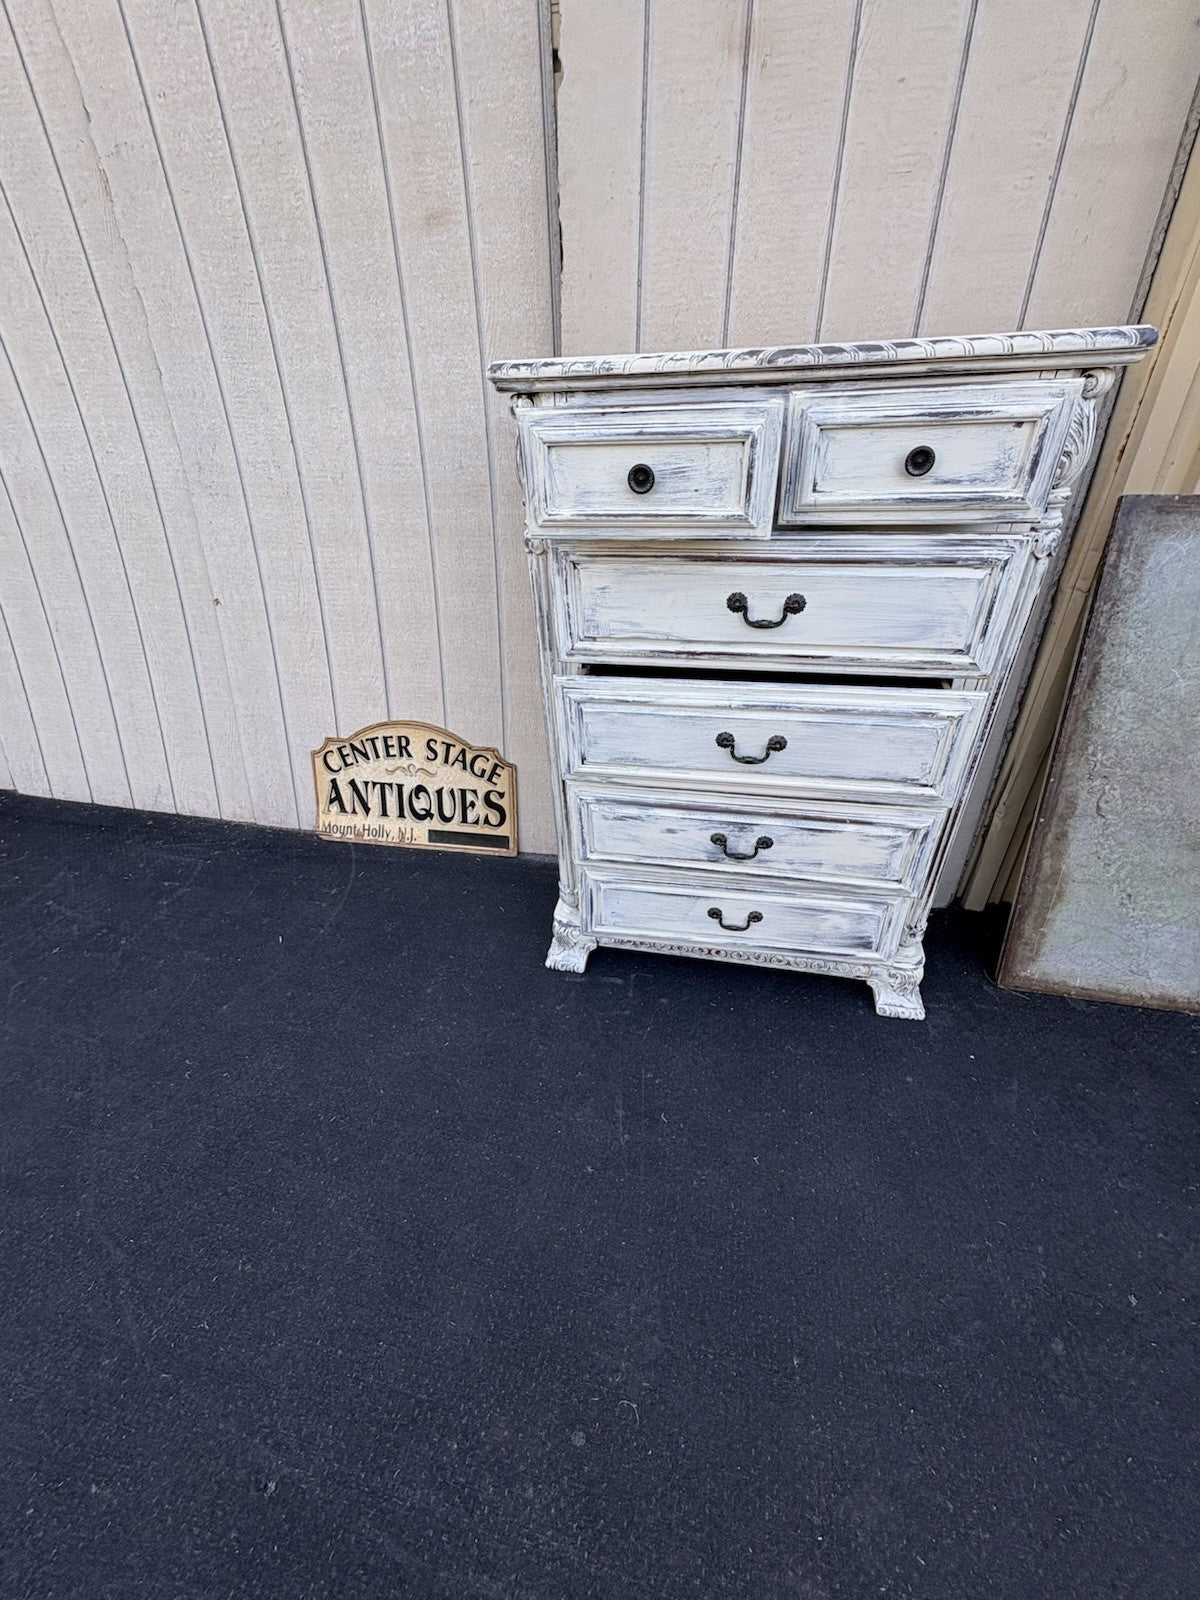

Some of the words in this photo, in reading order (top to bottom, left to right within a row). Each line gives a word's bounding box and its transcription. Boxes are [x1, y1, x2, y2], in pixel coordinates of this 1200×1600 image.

[323, 735, 413, 773] CENTER
[426, 738, 505, 786] STAGE
[324, 778, 507, 828] ANTIQUES
[321, 820, 358, 836] Mount
[362, 824, 395, 841] Holly,
[397, 827, 417, 843] N.J.
